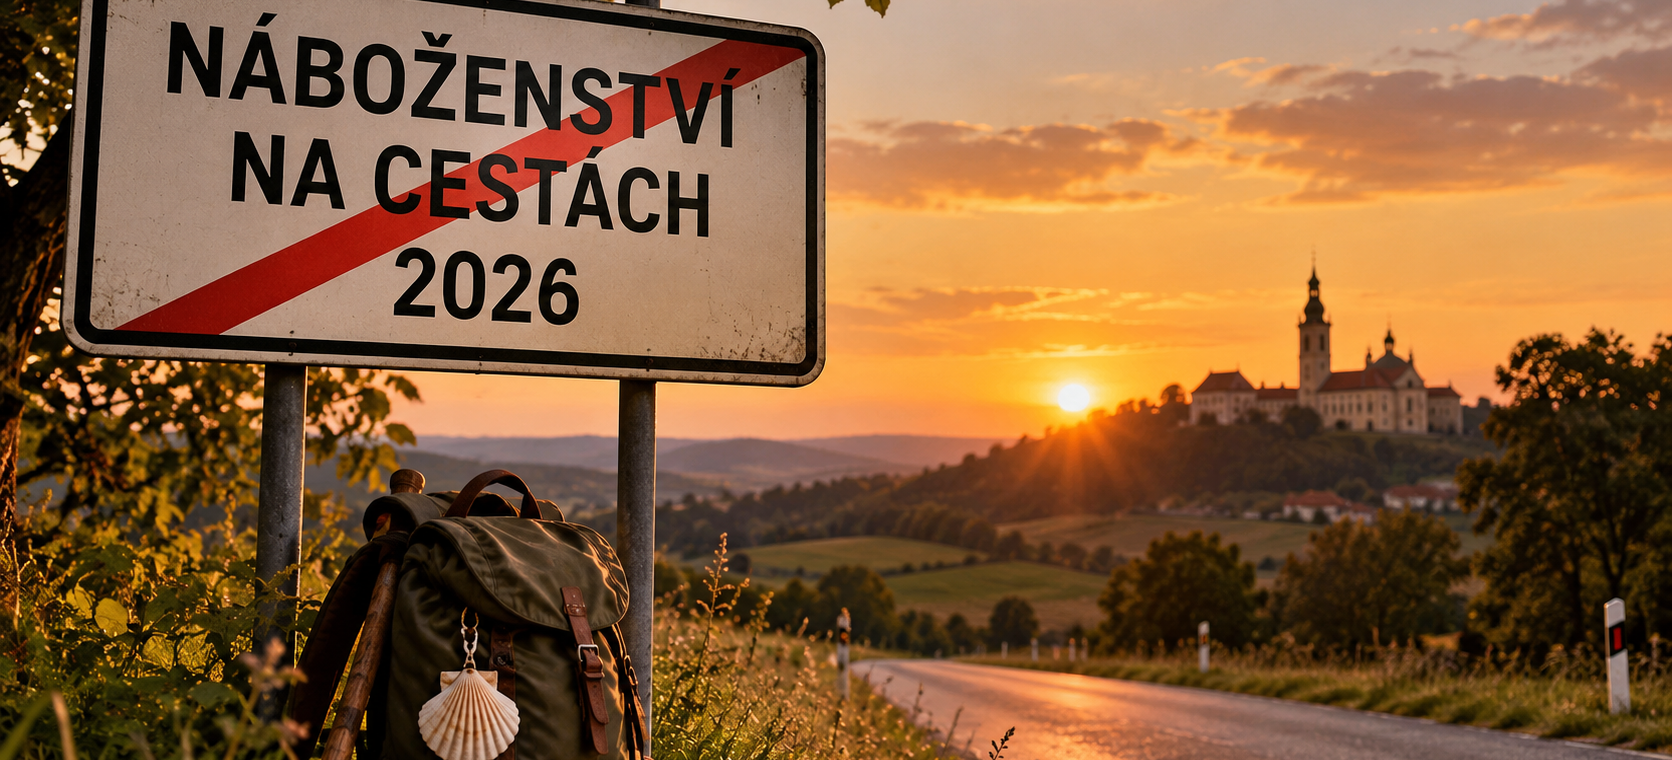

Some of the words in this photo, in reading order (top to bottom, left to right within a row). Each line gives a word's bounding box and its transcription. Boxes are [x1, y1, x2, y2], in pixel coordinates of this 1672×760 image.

[166, 12, 742, 148] NÁBOŽENSTVÍ
[231, 131, 346, 210] NA
[374, 145, 709, 238] CESTÁCH
[393, 247, 580, 326] 2026
